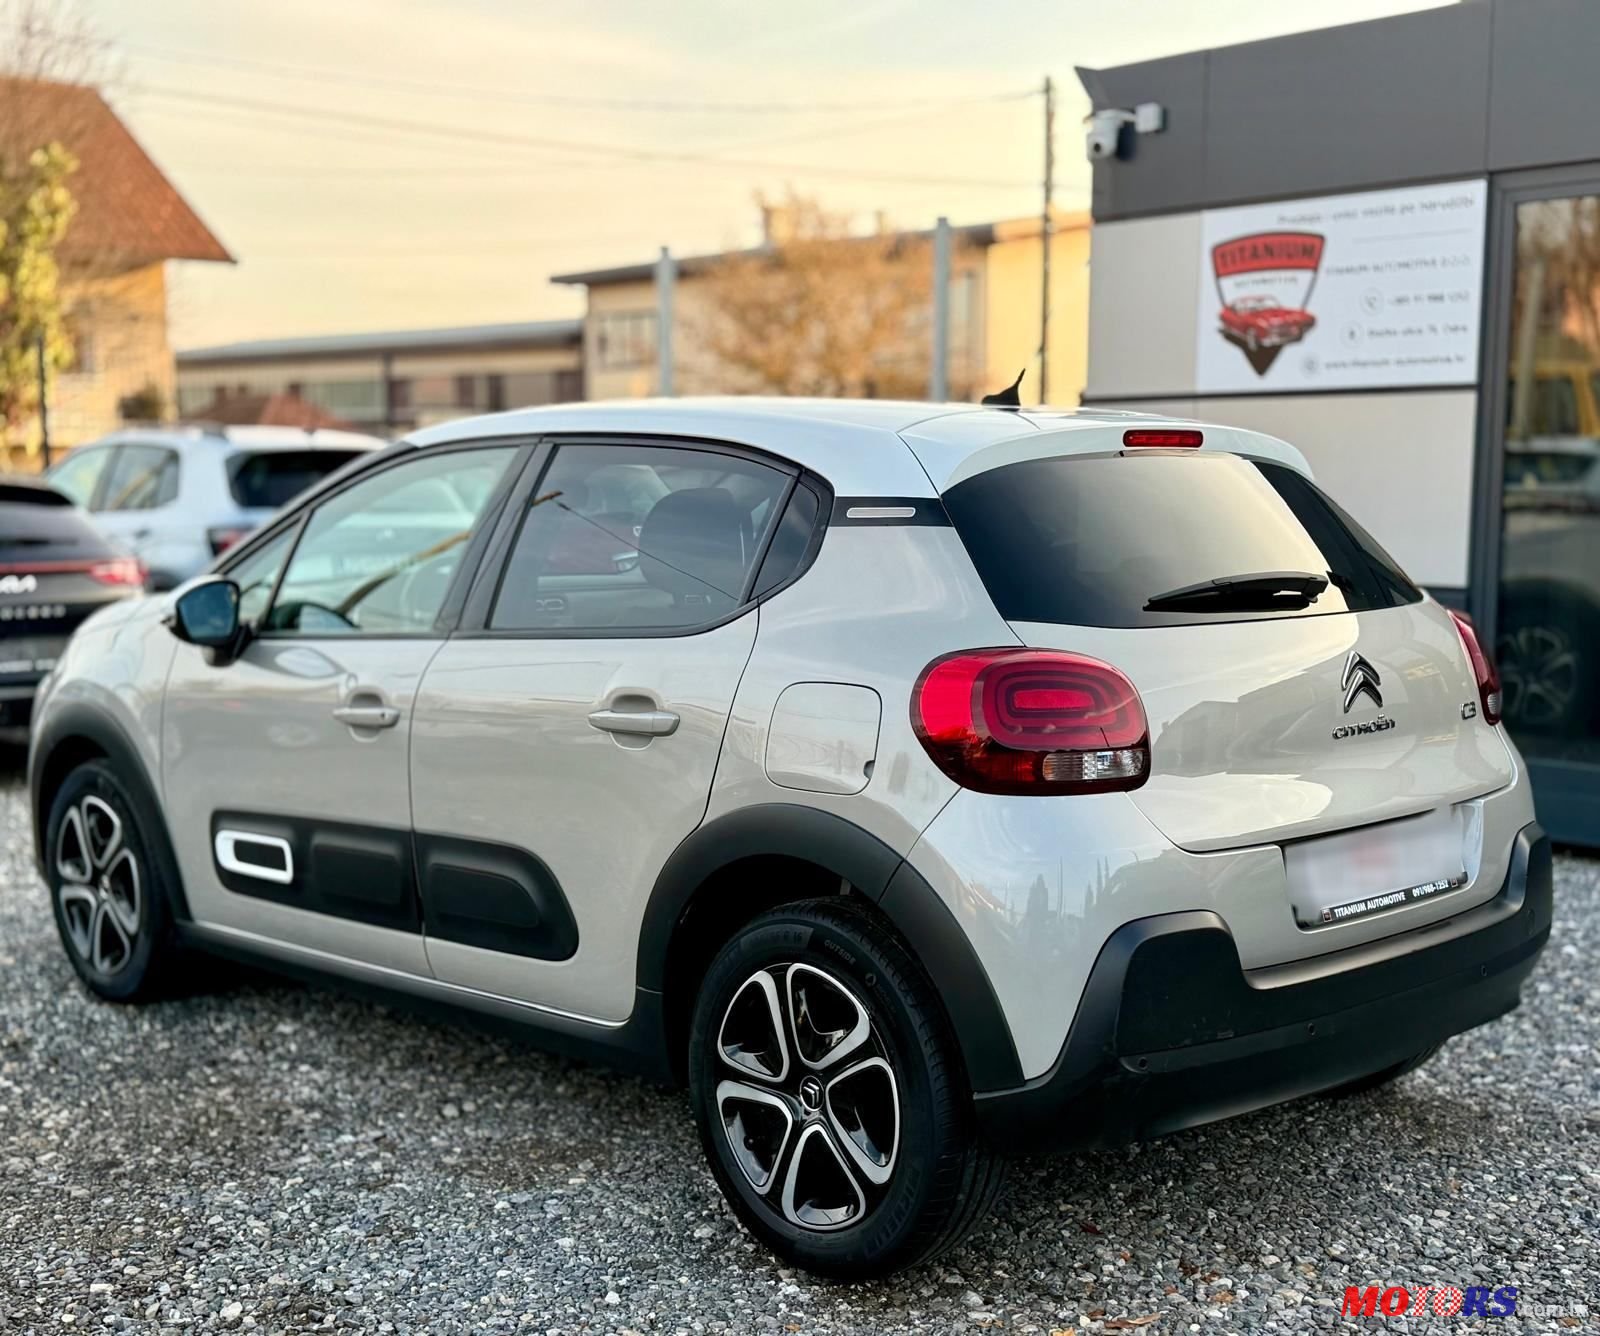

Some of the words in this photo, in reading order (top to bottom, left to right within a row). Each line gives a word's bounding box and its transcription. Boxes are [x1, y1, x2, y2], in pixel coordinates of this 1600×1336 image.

[1219, 242, 1316, 268] TITANIUM
[1461, 701, 1476, 720] C3
[1334, 901, 1367, 918] TITANIUM
[1367, 891, 1406, 910] AUTOMOTIVE
